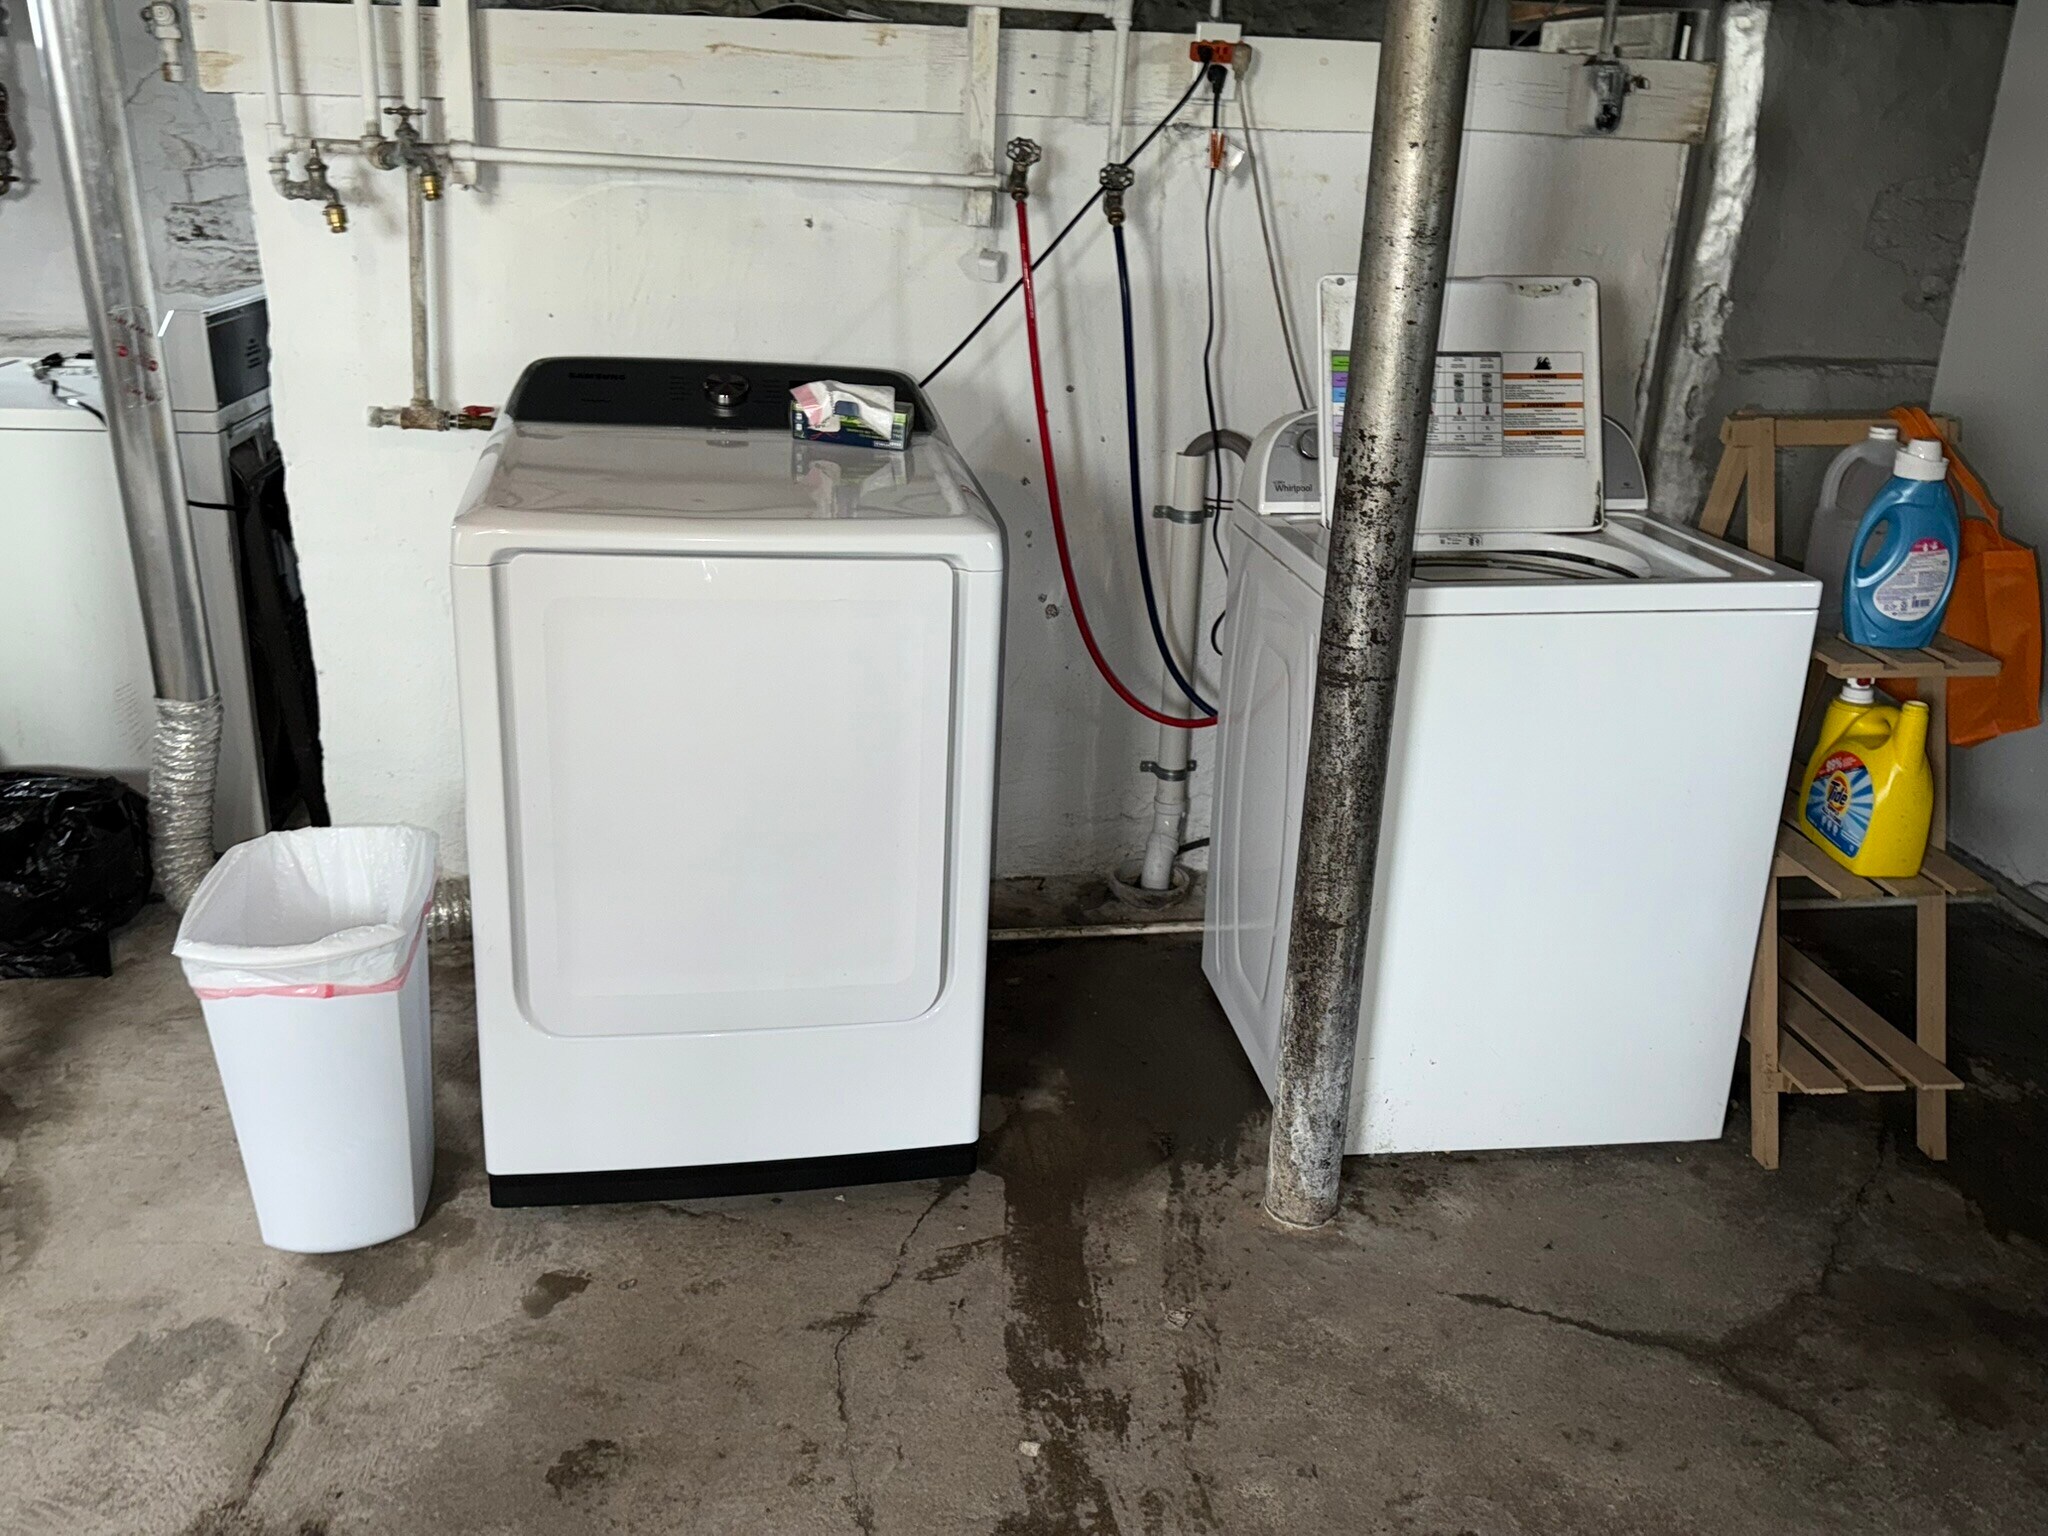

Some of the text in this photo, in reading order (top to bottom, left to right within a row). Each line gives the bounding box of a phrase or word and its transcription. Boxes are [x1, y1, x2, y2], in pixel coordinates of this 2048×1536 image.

[568, 372, 626, 380] SAMSUNG
[1275, 484, 1313, 494] Whirlpool
[1827, 780, 1848, 805] Tide
